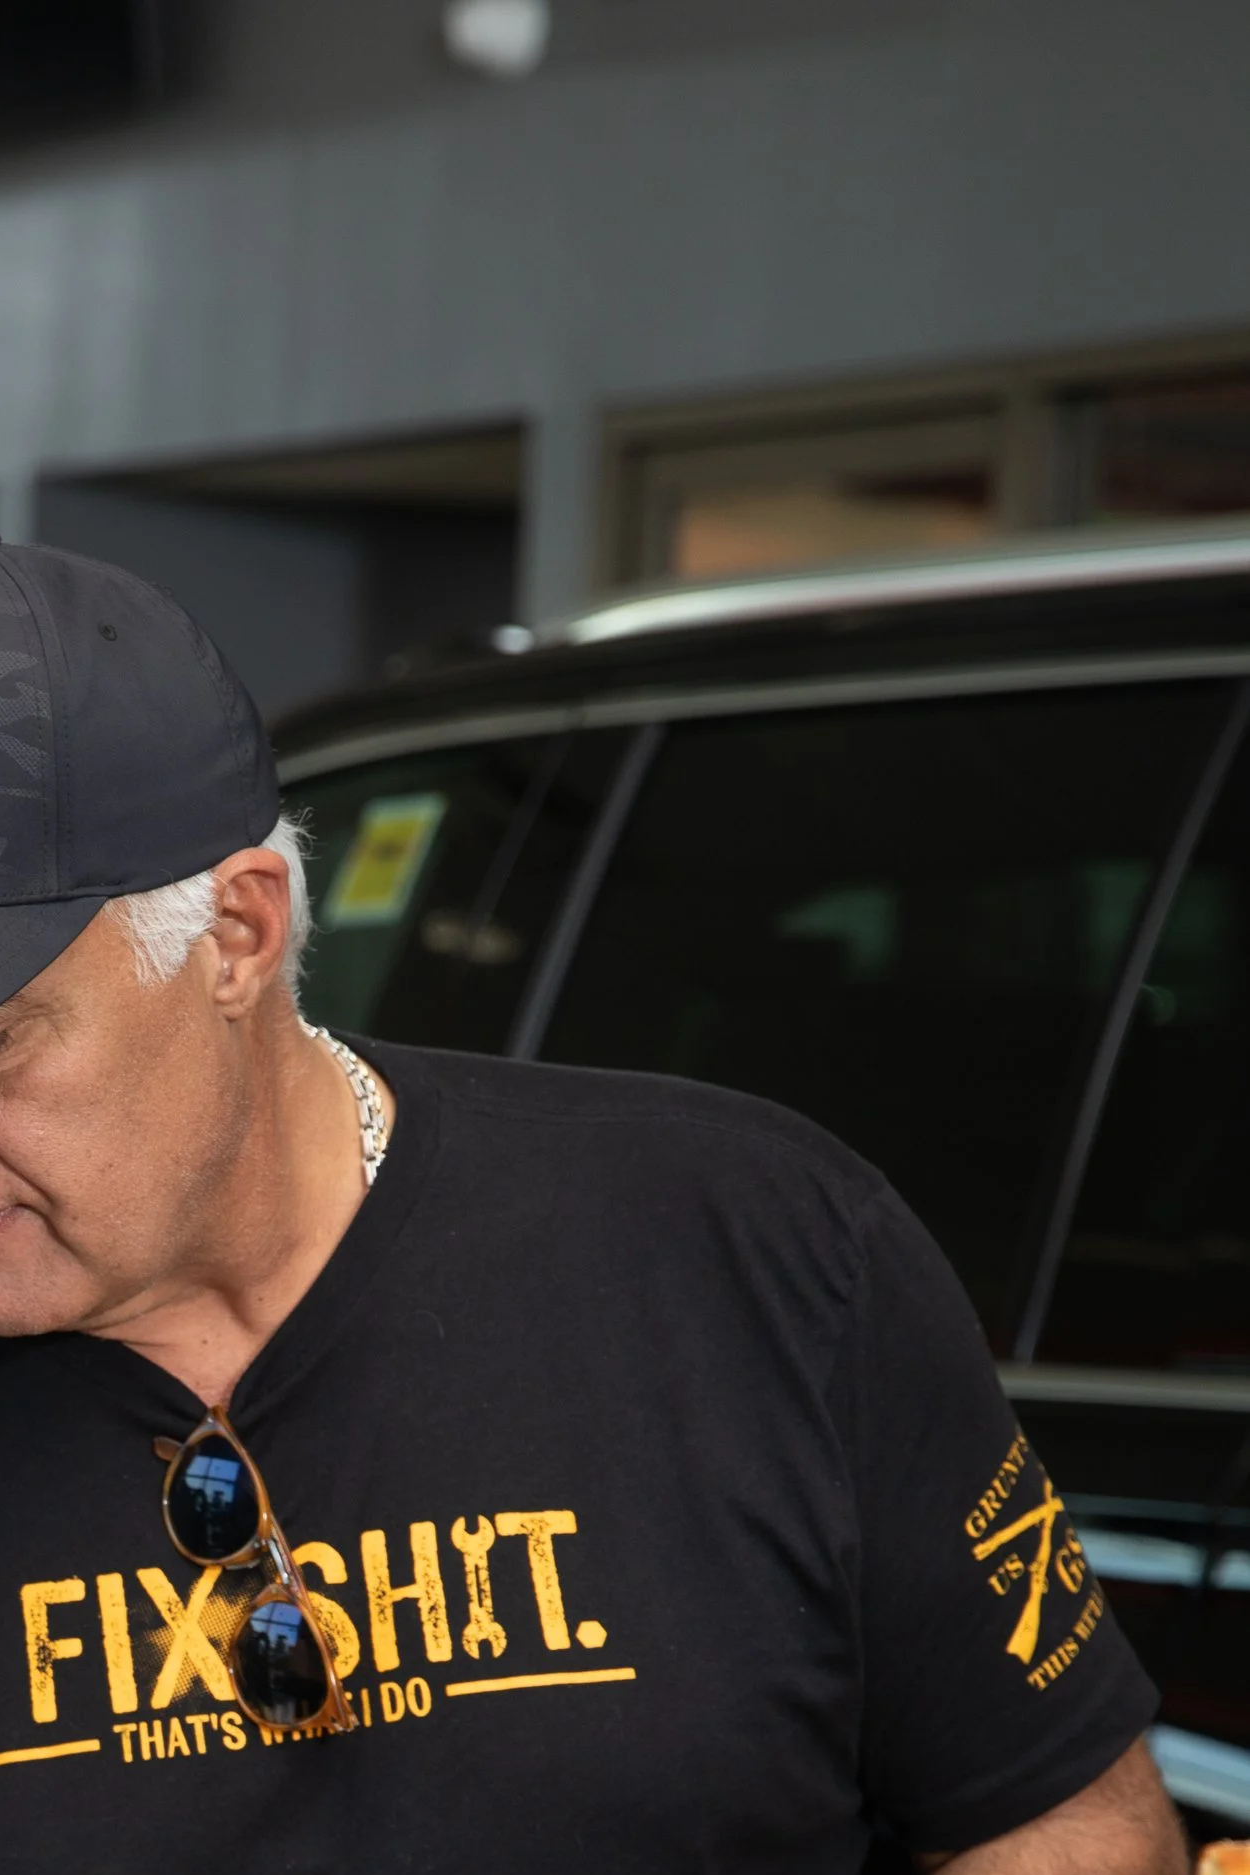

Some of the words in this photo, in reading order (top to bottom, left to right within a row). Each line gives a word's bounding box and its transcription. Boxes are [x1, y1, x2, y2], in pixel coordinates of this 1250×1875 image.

[21, 1566, 238, 1723] FIX
[1026, 1636, 1080, 1691] THIS
[112, 1711, 247, 1763] THAT'S
[360, 1688, 373, 1727] I
[379, 1677, 432, 1723] DO
